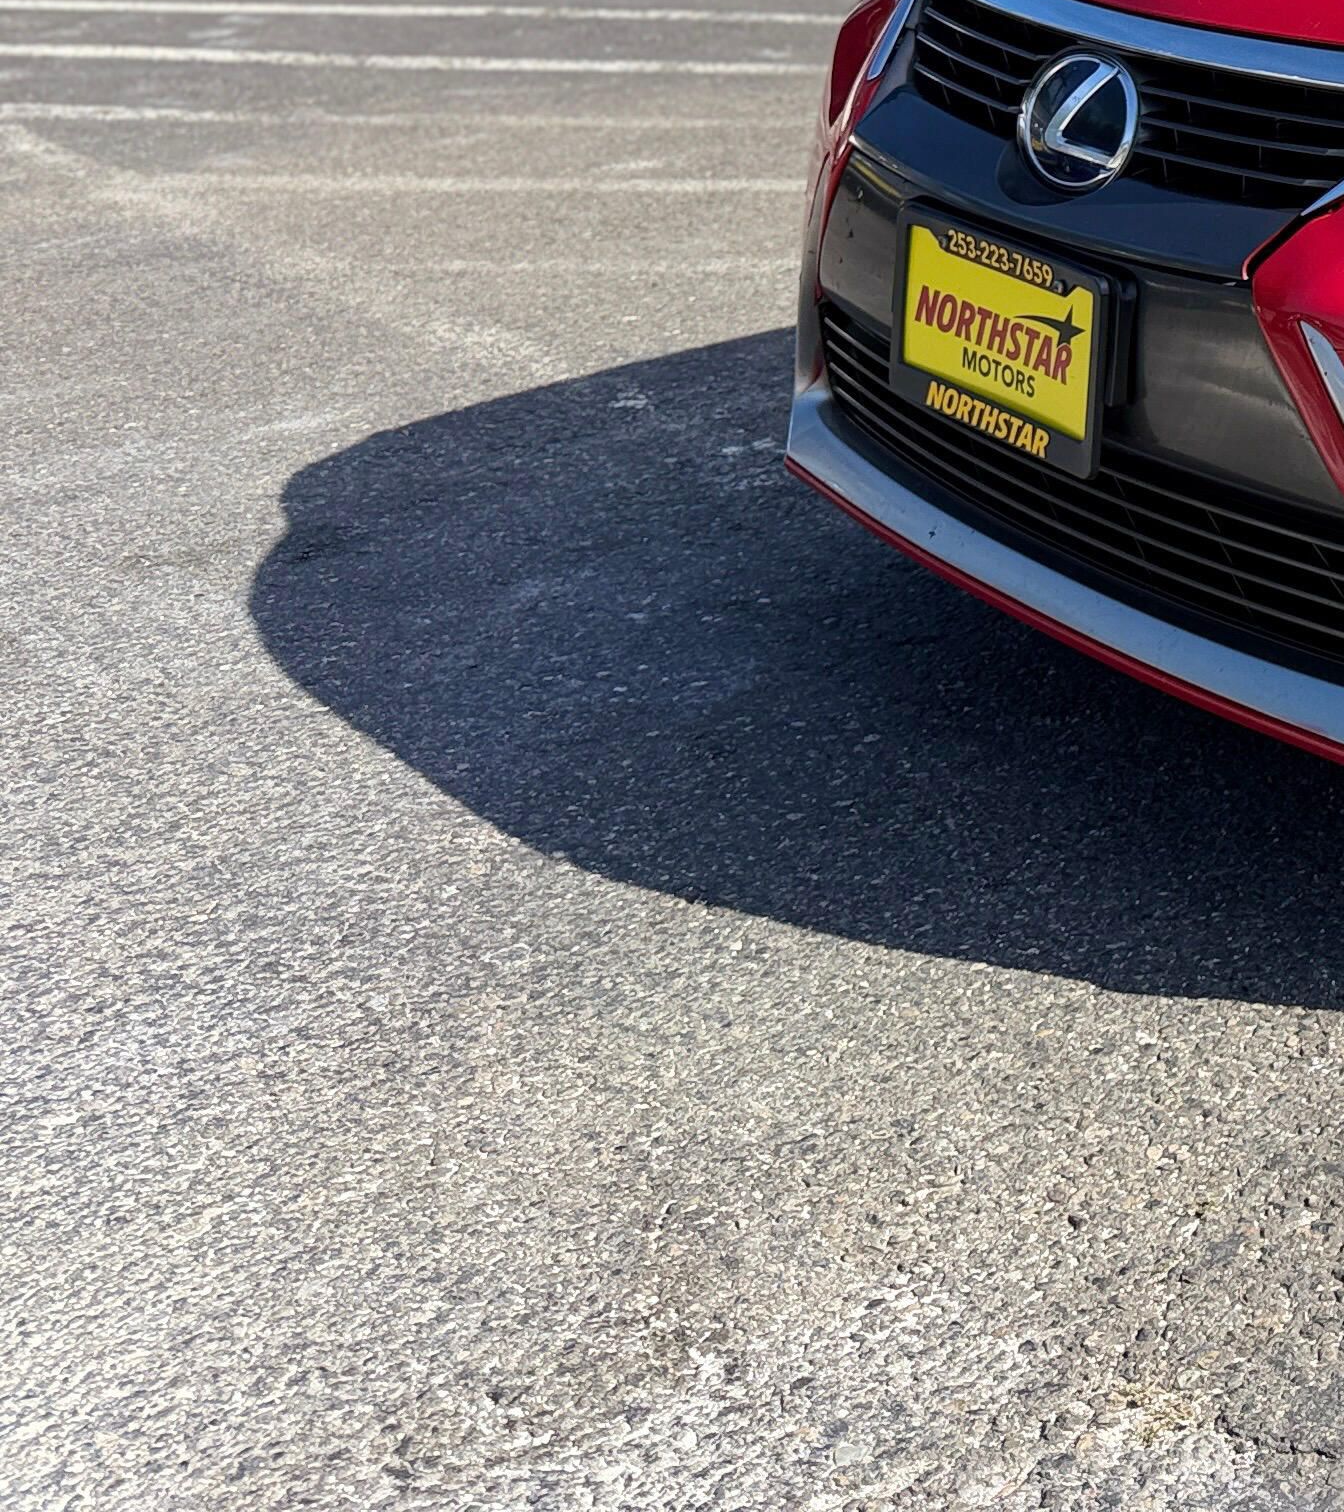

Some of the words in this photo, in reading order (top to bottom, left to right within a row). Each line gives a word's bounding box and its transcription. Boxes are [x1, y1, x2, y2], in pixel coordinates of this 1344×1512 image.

[947, 229, 1054, 287] 253-223-7659
[914, 285, 1073, 386] NORTHSTAR
[961, 346, 1036, 398] MOTORS
[926, 380, 1050, 459] NORTHSTAR
